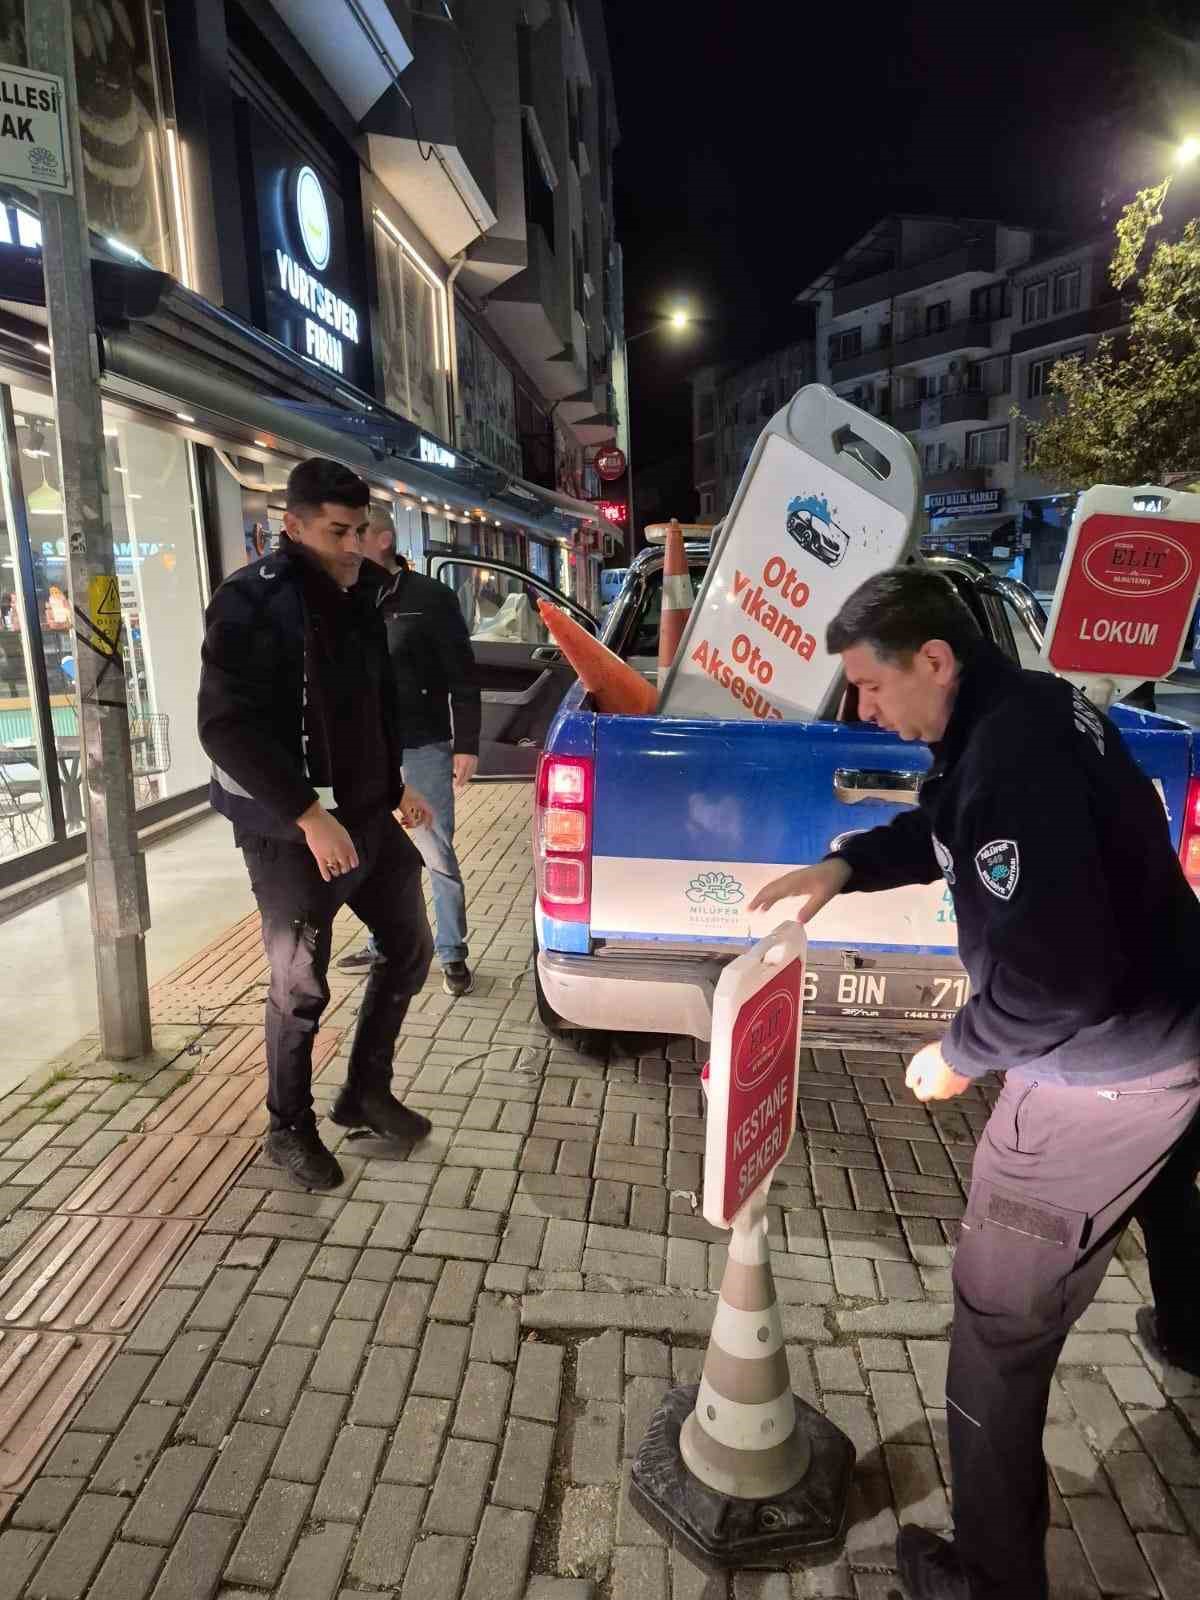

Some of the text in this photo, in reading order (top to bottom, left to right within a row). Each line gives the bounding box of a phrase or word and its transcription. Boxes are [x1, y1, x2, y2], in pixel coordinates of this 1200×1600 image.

[0, 81, 57, 113] LLESİ
[1, 113, 35, 143] AK
[276, 248, 359, 344] YURTSEVER
[763, 556, 811, 608] Oto
[1079, 618, 1159, 646] LOKUM
[731, 633, 774, 685] Oto
[802, 972, 819, 1002] 6
[837, 974, 887, 1006] BIN
[733, 1075, 788, 1162] KESTANE
